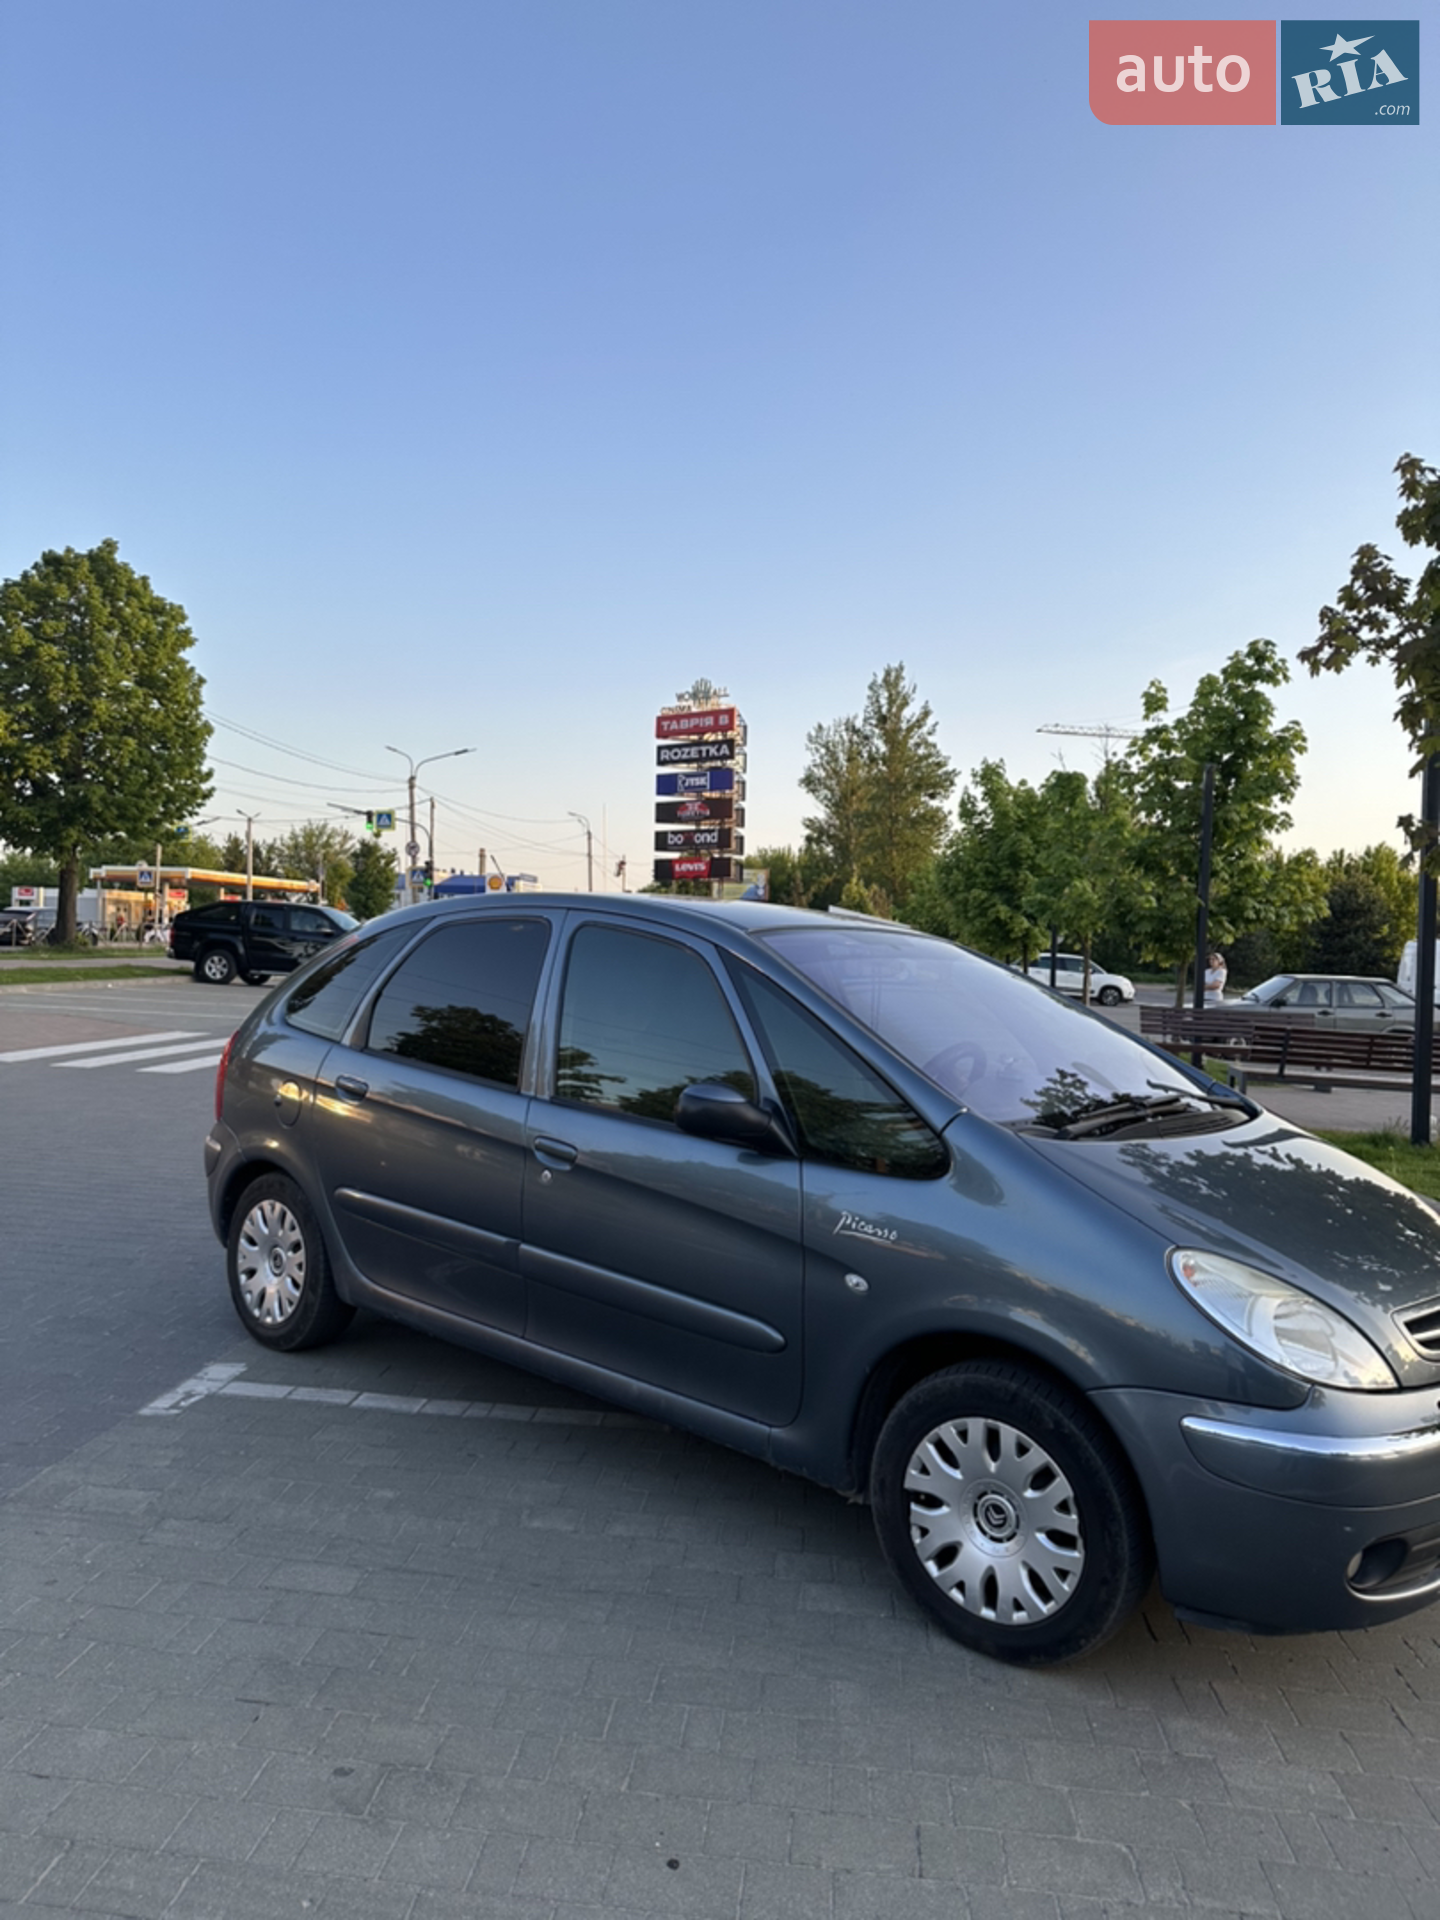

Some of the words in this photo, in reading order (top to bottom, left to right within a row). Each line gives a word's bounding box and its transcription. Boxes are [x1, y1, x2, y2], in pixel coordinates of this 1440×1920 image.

[661, 716, 714, 731] ТАВРІЯ
[719, 714, 730, 726] В
[660, 744, 730, 760] ROZETKA
